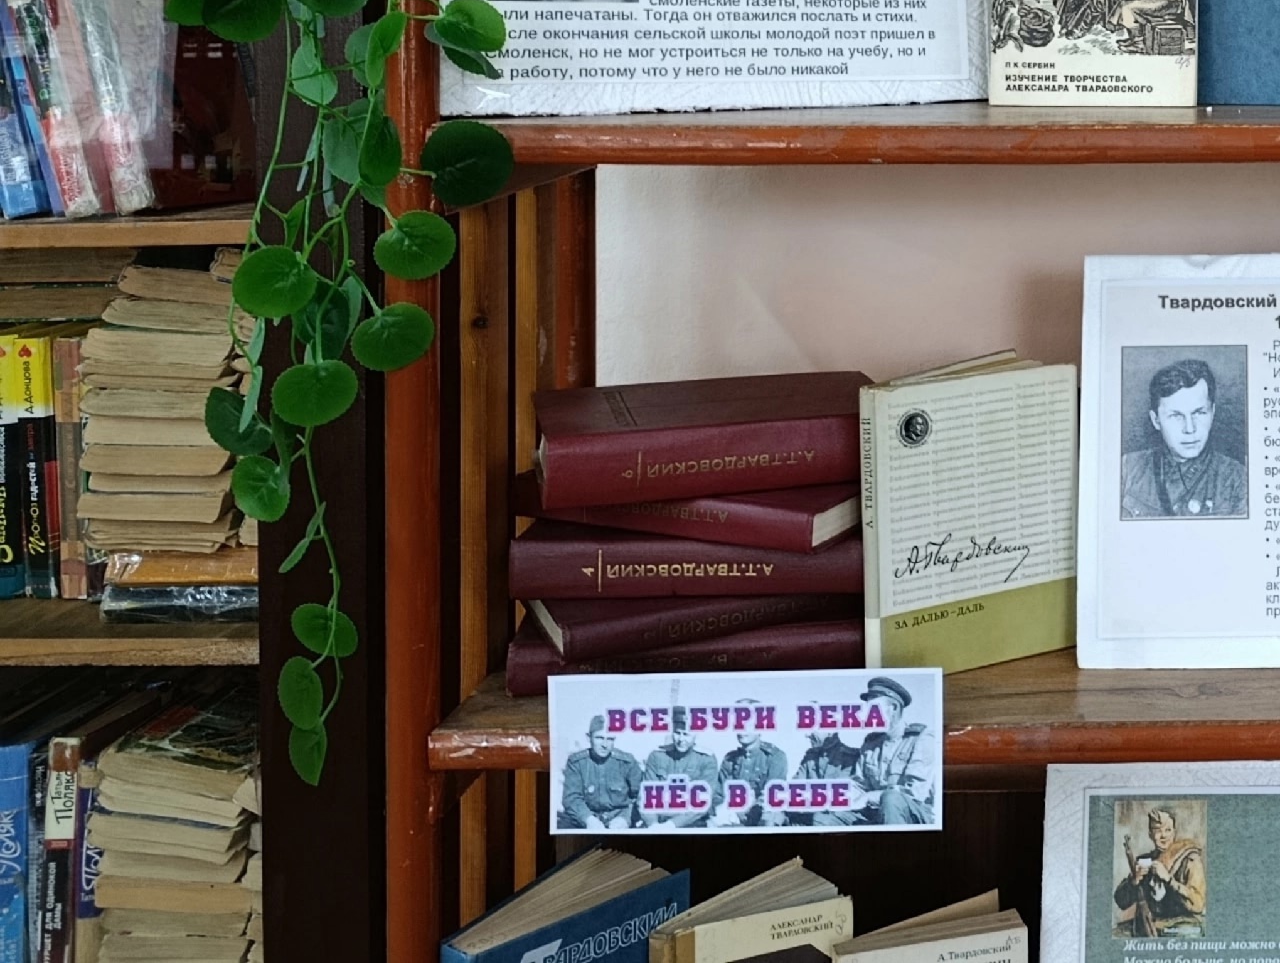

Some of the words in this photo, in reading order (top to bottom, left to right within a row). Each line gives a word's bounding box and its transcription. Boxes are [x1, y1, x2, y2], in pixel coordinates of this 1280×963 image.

[1064, 75, 1127, 83] ТВОРЧЕСТВА
[1158, 294, 1276, 312] Твардовский
[862, 417, 874, 510] ТВАРДОВСКИЙ
[895, 619, 908, 630] ЗА
[607, 707, 669, 733] ВСЕ
[690, 706, 776, 732] БУРИ
[797, 703, 887, 730] ВЕКА
[643, 777, 708, 810] НЁС
[728, 783, 747, 809] В
[767, 781, 850, 809] СЕБЕ
[771, 915, 823, 932] АЛЕКСАНДР
[771, 922, 835, 940] ТВАРДОВСКИЙ
